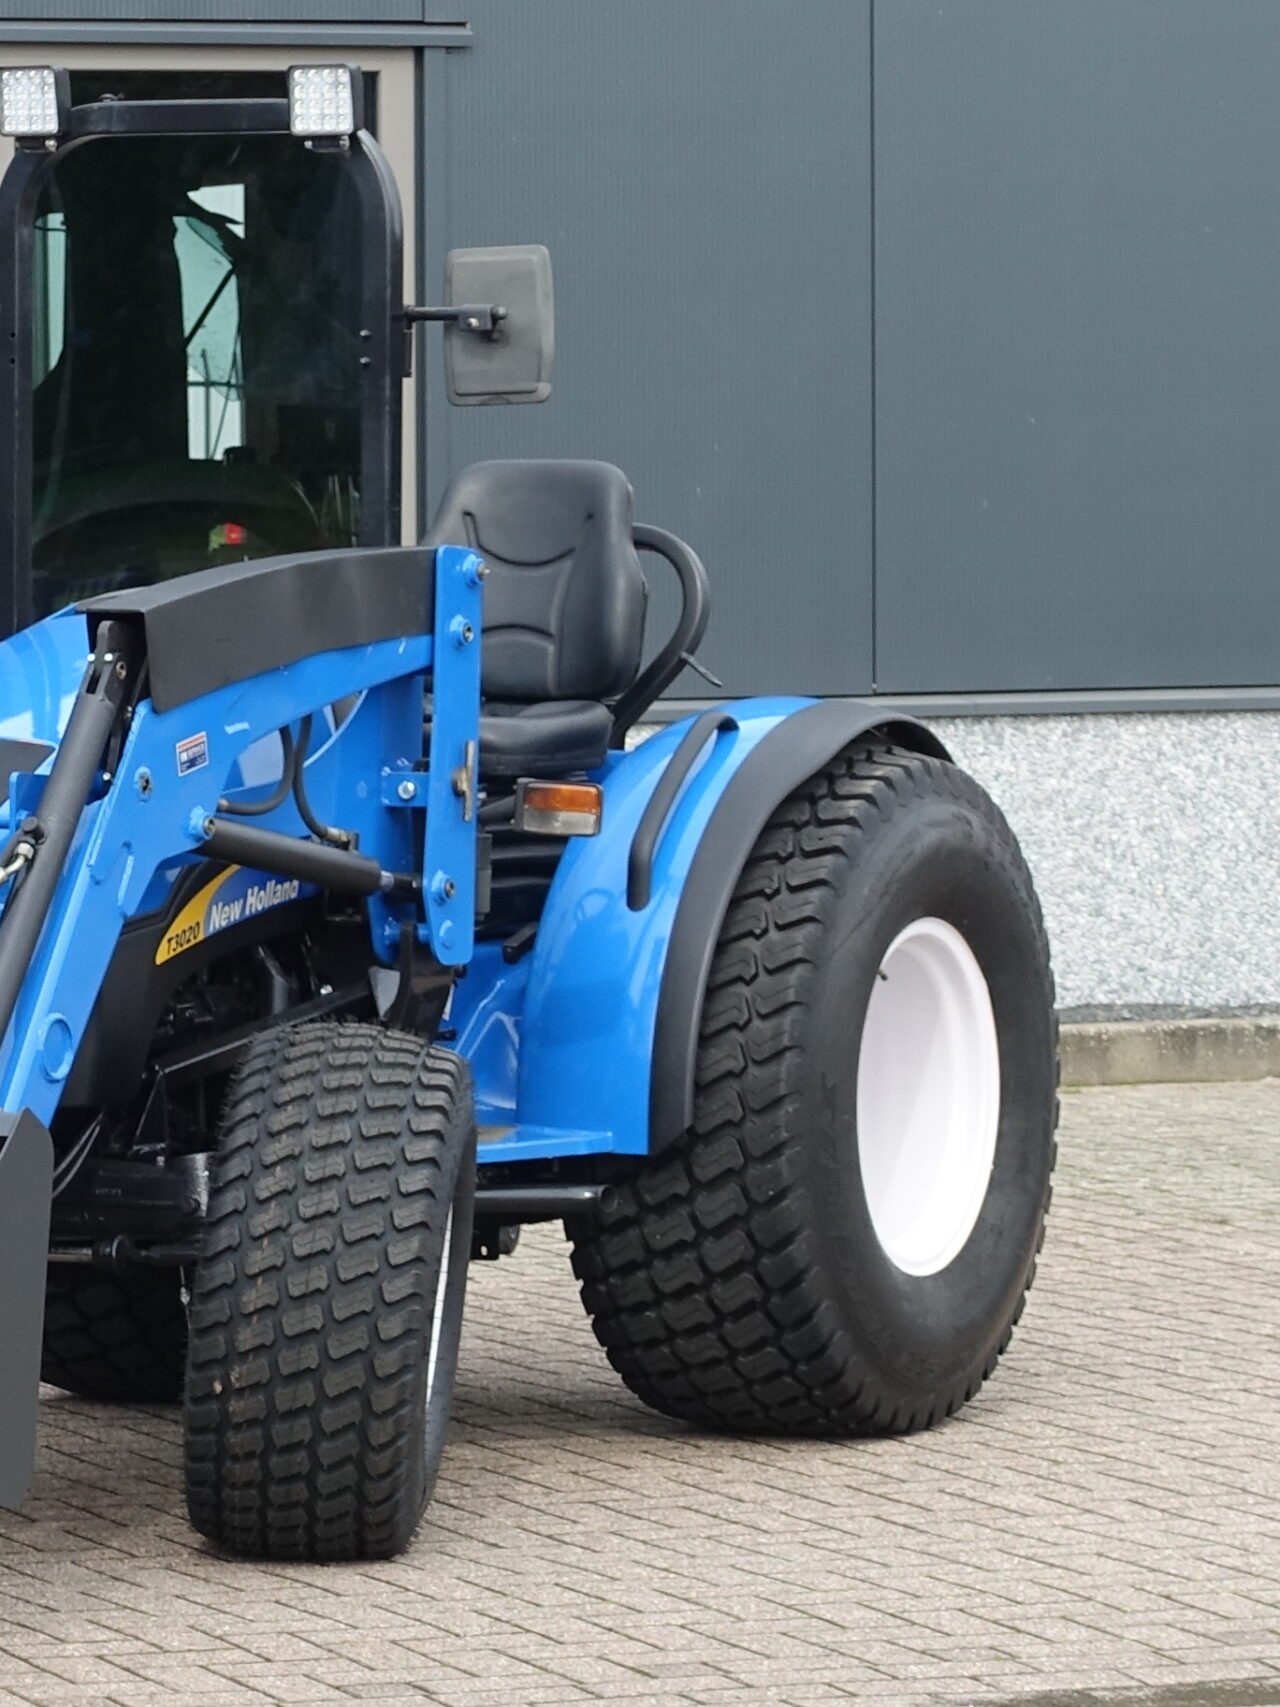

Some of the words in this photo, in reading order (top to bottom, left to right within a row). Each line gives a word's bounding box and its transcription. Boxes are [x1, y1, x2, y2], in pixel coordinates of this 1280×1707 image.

[209, 900, 244, 933] New
[245, 879, 300, 916] Holland
[166, 921, 201, 955] T3020
